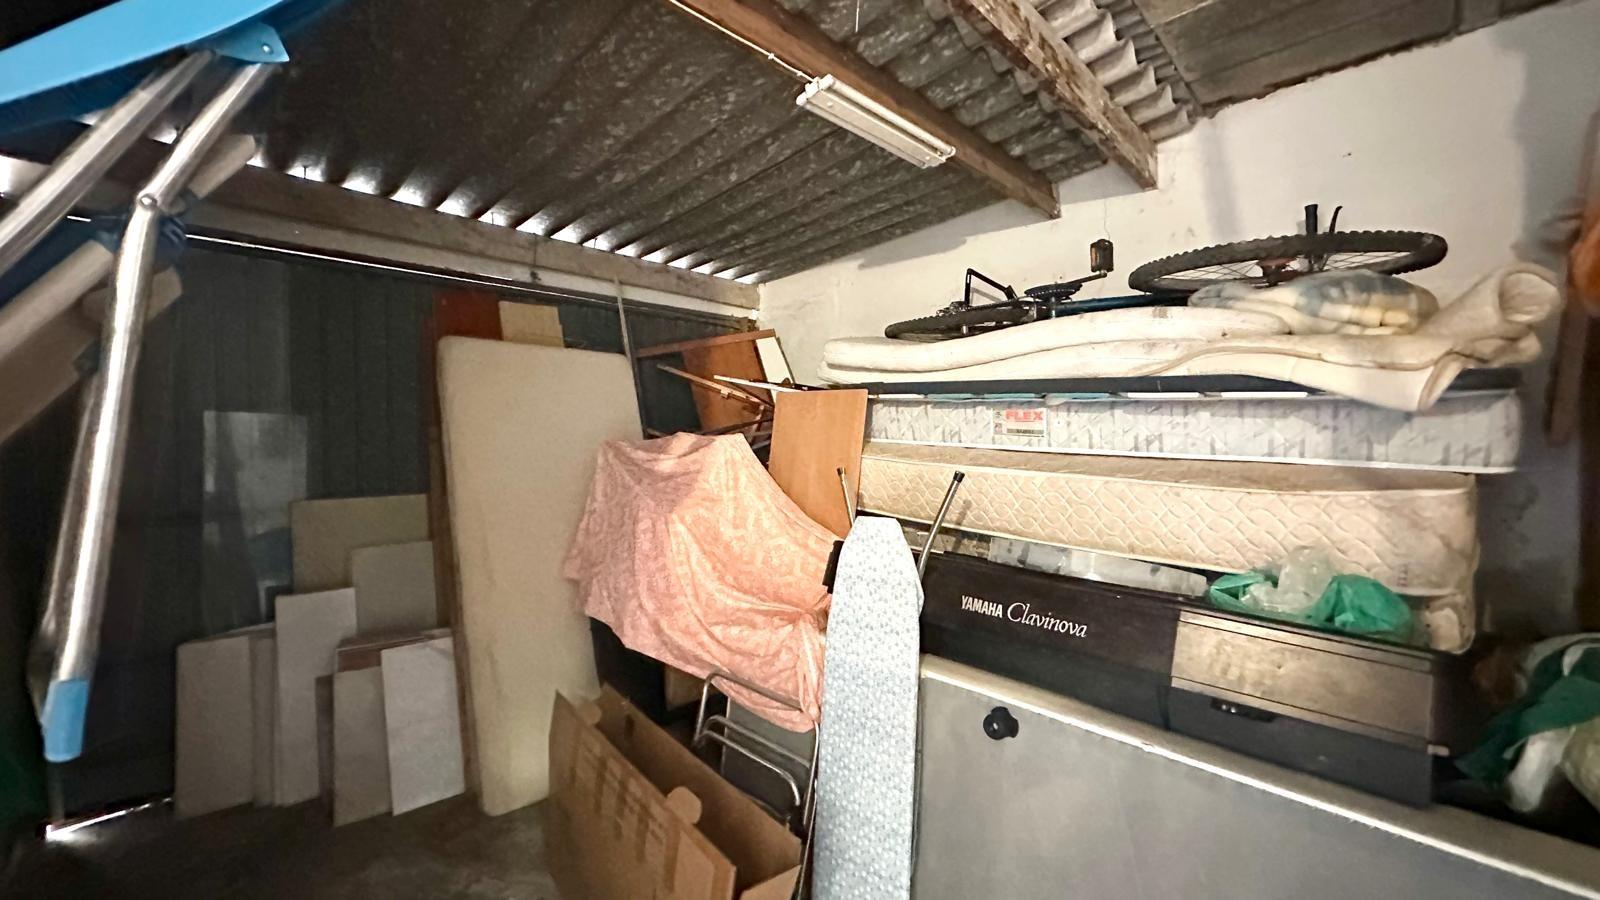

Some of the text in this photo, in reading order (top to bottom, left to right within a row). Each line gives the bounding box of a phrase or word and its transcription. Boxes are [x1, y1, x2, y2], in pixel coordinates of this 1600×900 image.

[1005, 410, 1044, 421] FLEX
[961, 595, 1088, 638] YAMAHA Clavinova
